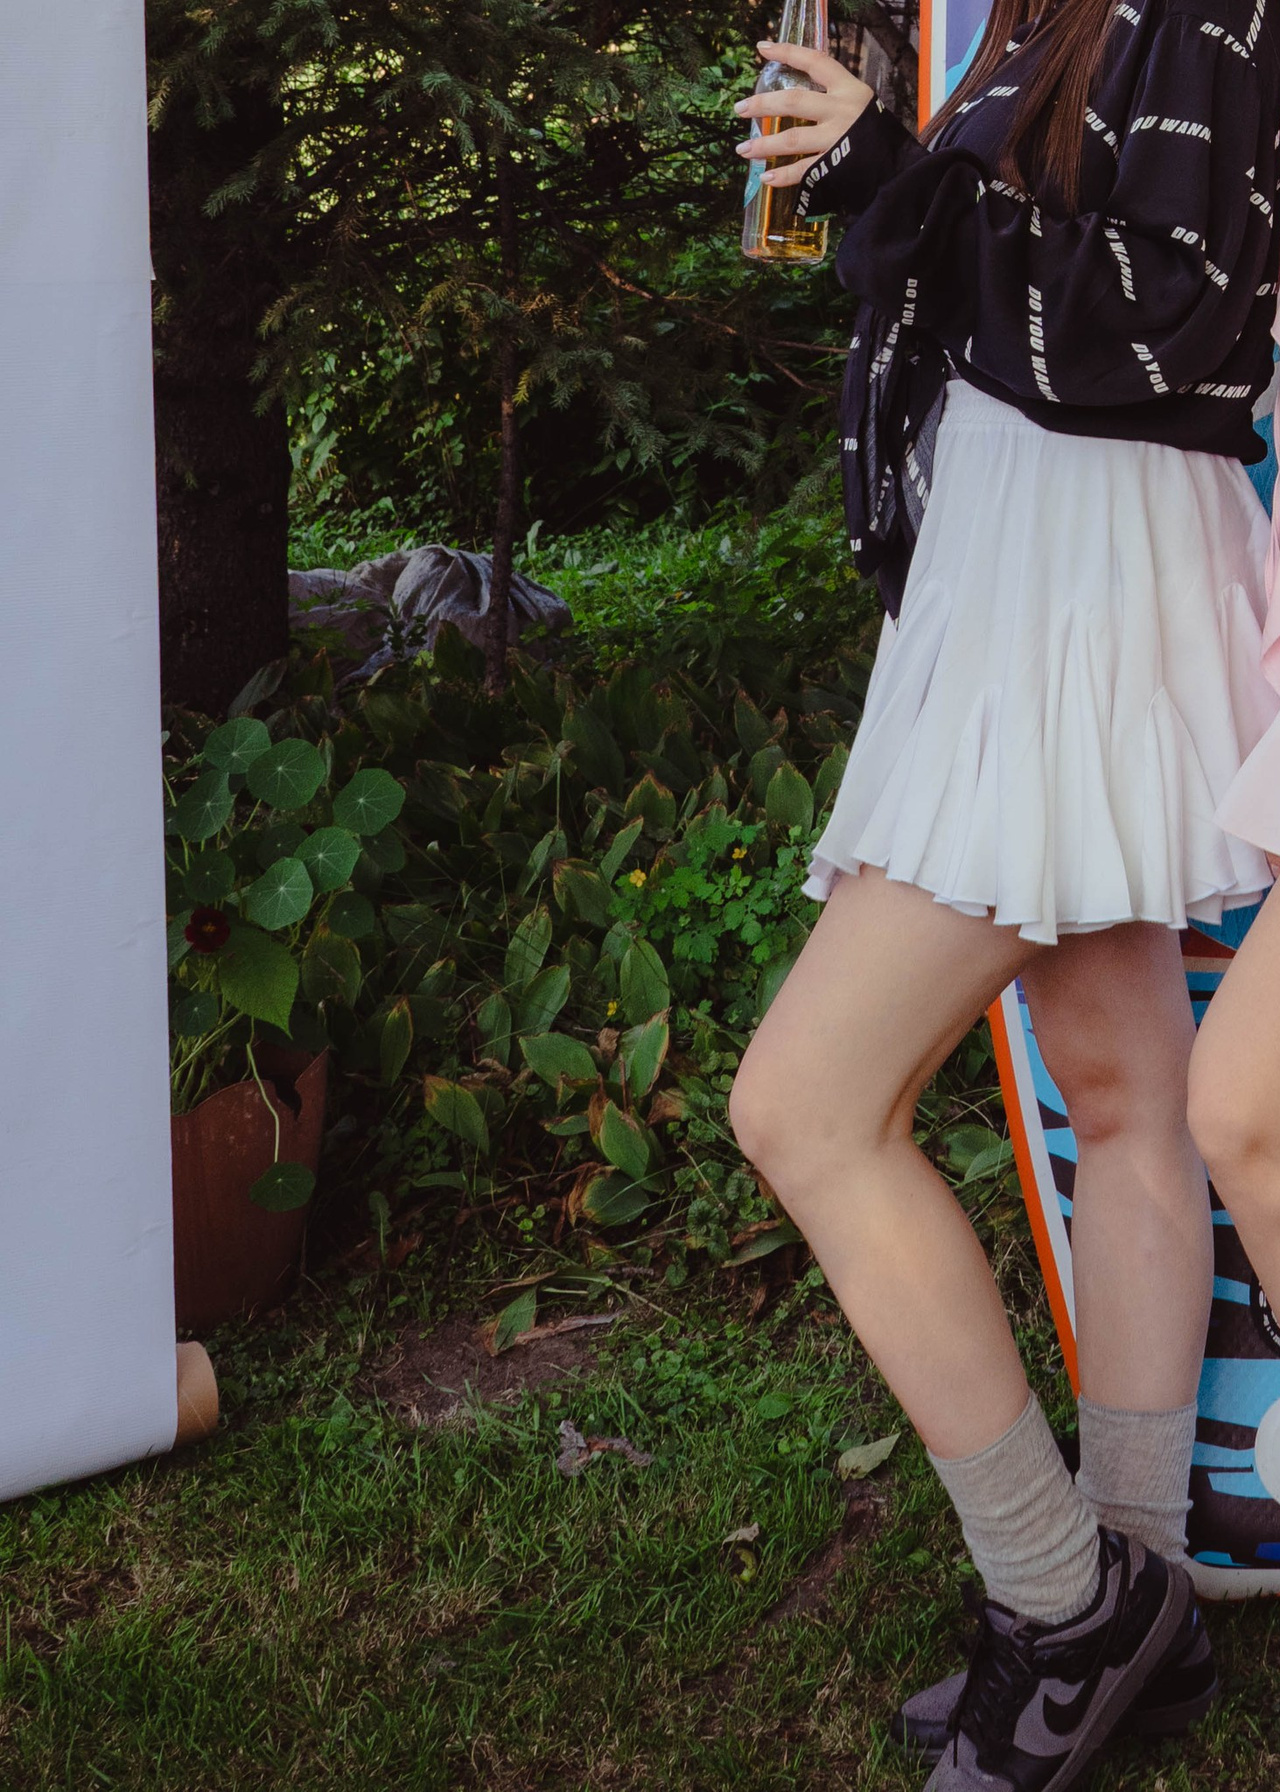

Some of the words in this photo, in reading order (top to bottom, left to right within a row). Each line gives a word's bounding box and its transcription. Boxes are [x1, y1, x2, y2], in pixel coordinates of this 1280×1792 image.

[1200, 21, 1226, 38] DO
[829, 135, 851, 168] DO
[805, 160, 829, 189] YOU
[1170, 226, 1200, 246] DO
[1108, 241, 1137, 302] WANNA
[905, 277, 919, 300] DO
[1028, 284, 1043, 313] DO
[901, 302, 917, 327] YOU
[1028, 314, 1046, 354] YOU
[1131, 342, 1154, 362] DO
[1145, 361, 1170, 395] YOU
[1194, 382, 1252, 399] WANNA
